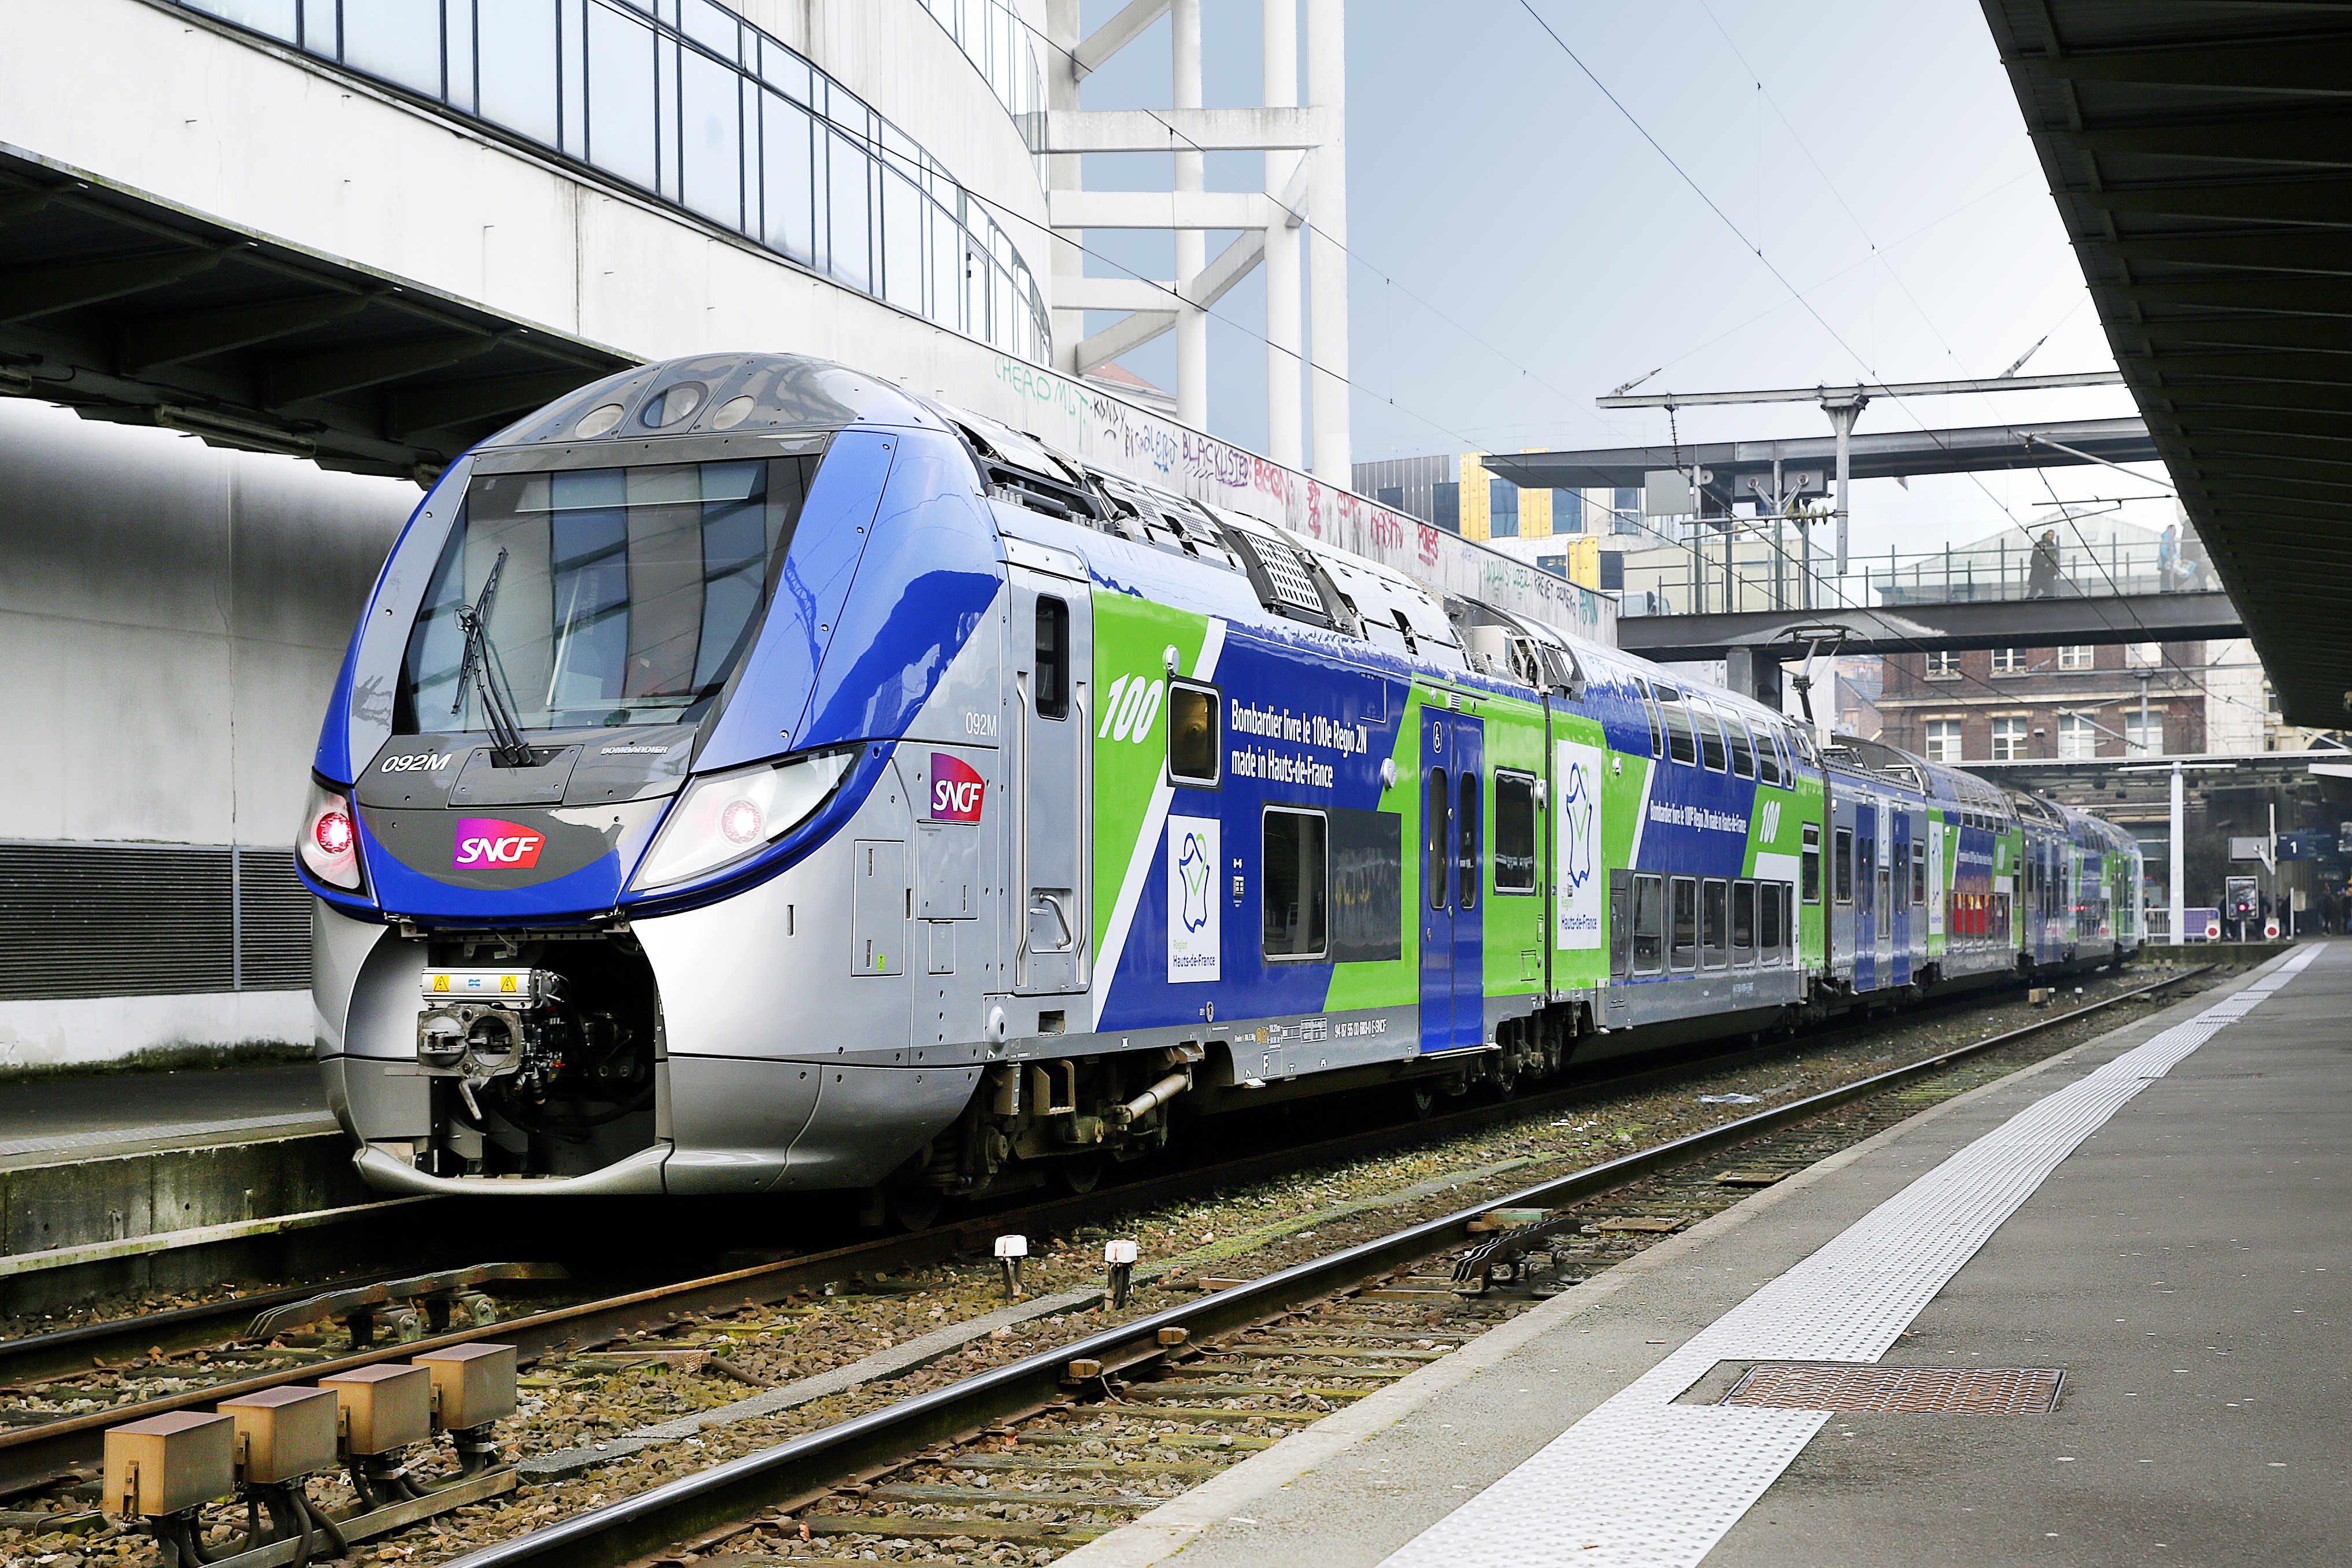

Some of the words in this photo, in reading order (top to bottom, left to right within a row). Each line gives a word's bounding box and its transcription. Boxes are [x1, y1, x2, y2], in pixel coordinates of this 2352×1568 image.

[1097, 672, 1164, 744] 100
[966, 712, 997, 737] 092M
[1232, 698, 1282, 738] Bombardier
[1284, 708, 1301, 742] livre
[1303, 712, 1311, 744] le
[1312, 715, 1332, 748] 100e
[1333, 720, 1355, 758] Regio
[1356, 724, 1367, 754] 2N
[381, 753, 452, 773] 092M
[600, 746, 668, 755] BOMBARDIER
[1232, 744, 1256, 778] made
[1258, 746, 1266, 778] in
[1268, 749, 1333, 788] Hauts-de-France
[933, 780, 982, 812] SNCF
[1759, 800, 1781, 844] 100
[456, 837, 539, 863] SNCF
[2290, 841, 2297, 854] 1
[1173, 940, 1188, 952] Région
[1173, 954, 1215, 967] Hauts-de-France
